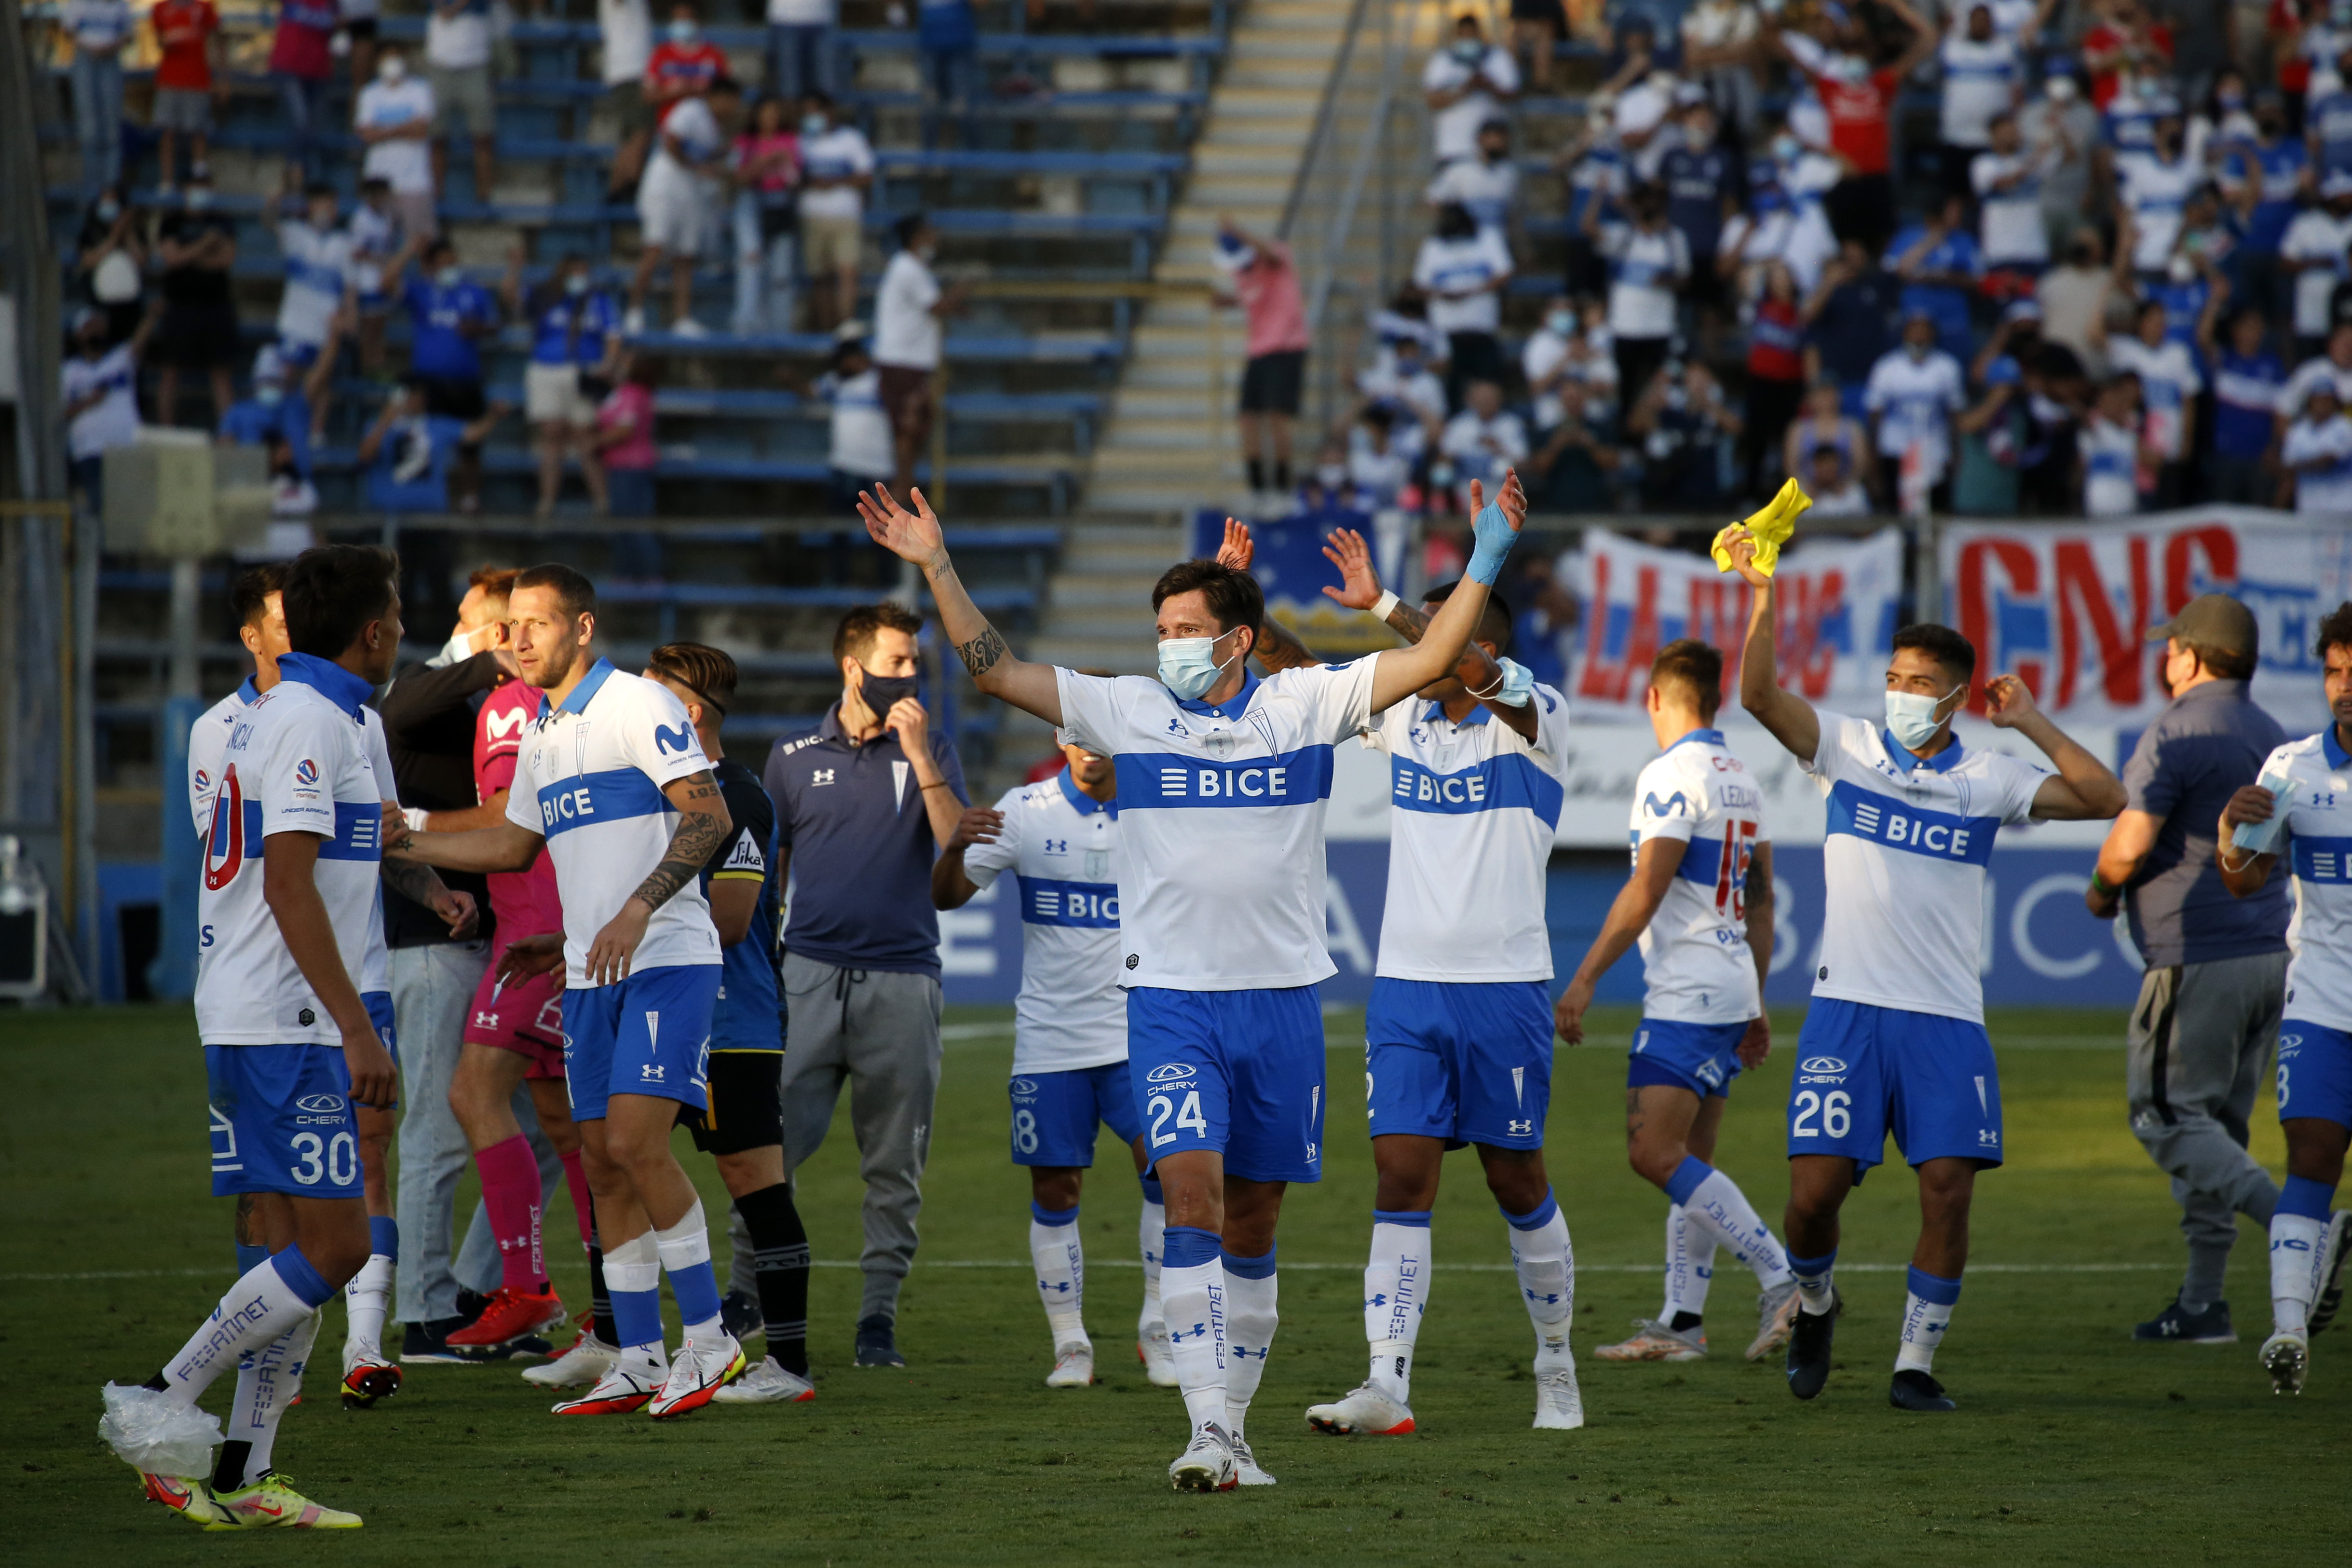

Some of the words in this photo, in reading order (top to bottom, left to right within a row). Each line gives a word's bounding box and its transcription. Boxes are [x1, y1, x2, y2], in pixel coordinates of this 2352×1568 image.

[796, 735, 823, 749] BIC
[667, 756, 687, 766] UNDER
[1198, 767, 1287, 797] BICE
[1418, 775, 1485, 804] BICE
[542, 788, 594, 827] BICE
[1886, 815, 1971, 856] BICE
[730, 841, 762, 866] Sika
[1068, 893, 1120, 920] BIC
[1147, 1081, 1197, 1097] CHERY
[1799, 1075, 1847, 1085] CHERY
[296, 1115, 347, 1125] CHERY
[1147, 1091, 1207, 1149] 24
[1793, 1090, 1852, 1138] 26
[290, 1132, 356, 1186] 30
